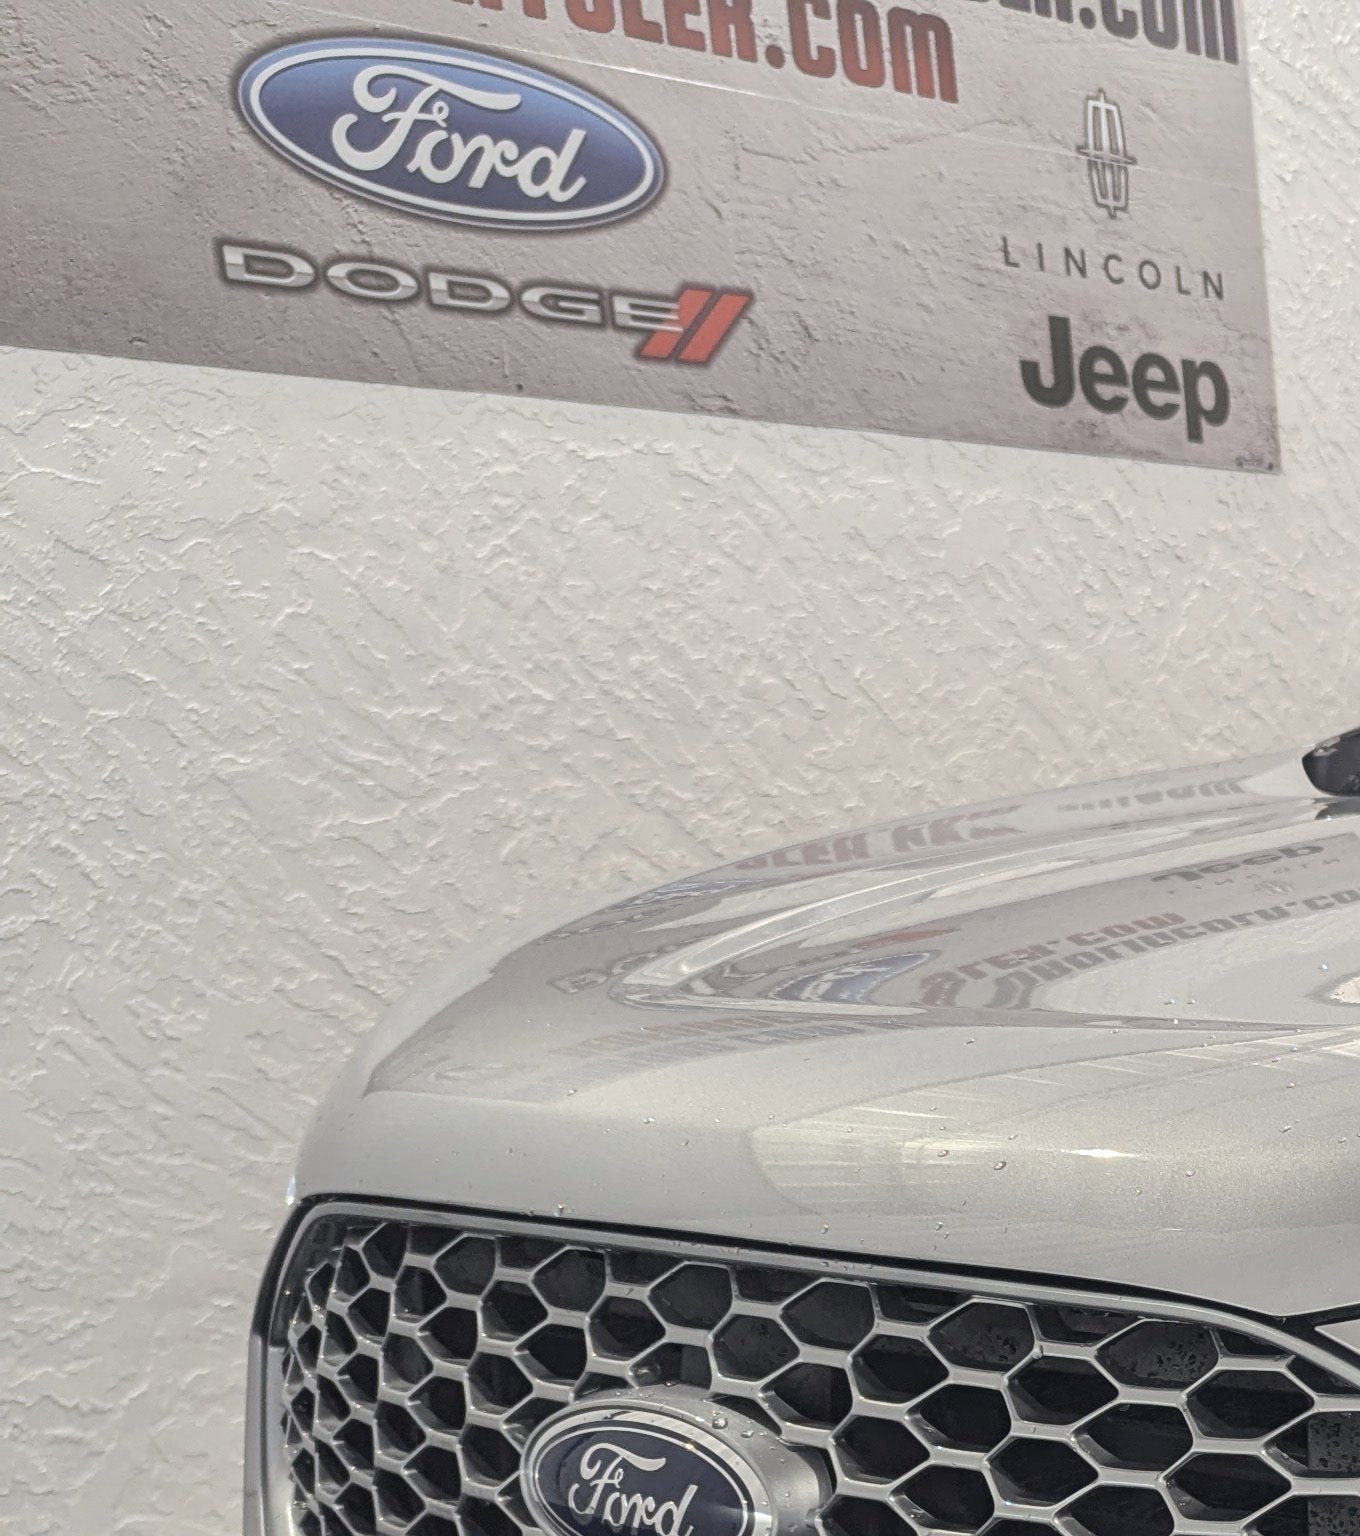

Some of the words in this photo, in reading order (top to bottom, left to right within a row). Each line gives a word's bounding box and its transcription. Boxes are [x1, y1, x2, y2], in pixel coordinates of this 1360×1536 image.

[331, 64, 587, 203] Ford
[221, 244, 685, 333] DODGE
[1001, 235, 1225, 301] LINCOLN
[1019, 315, 1232, 444] Jeep
